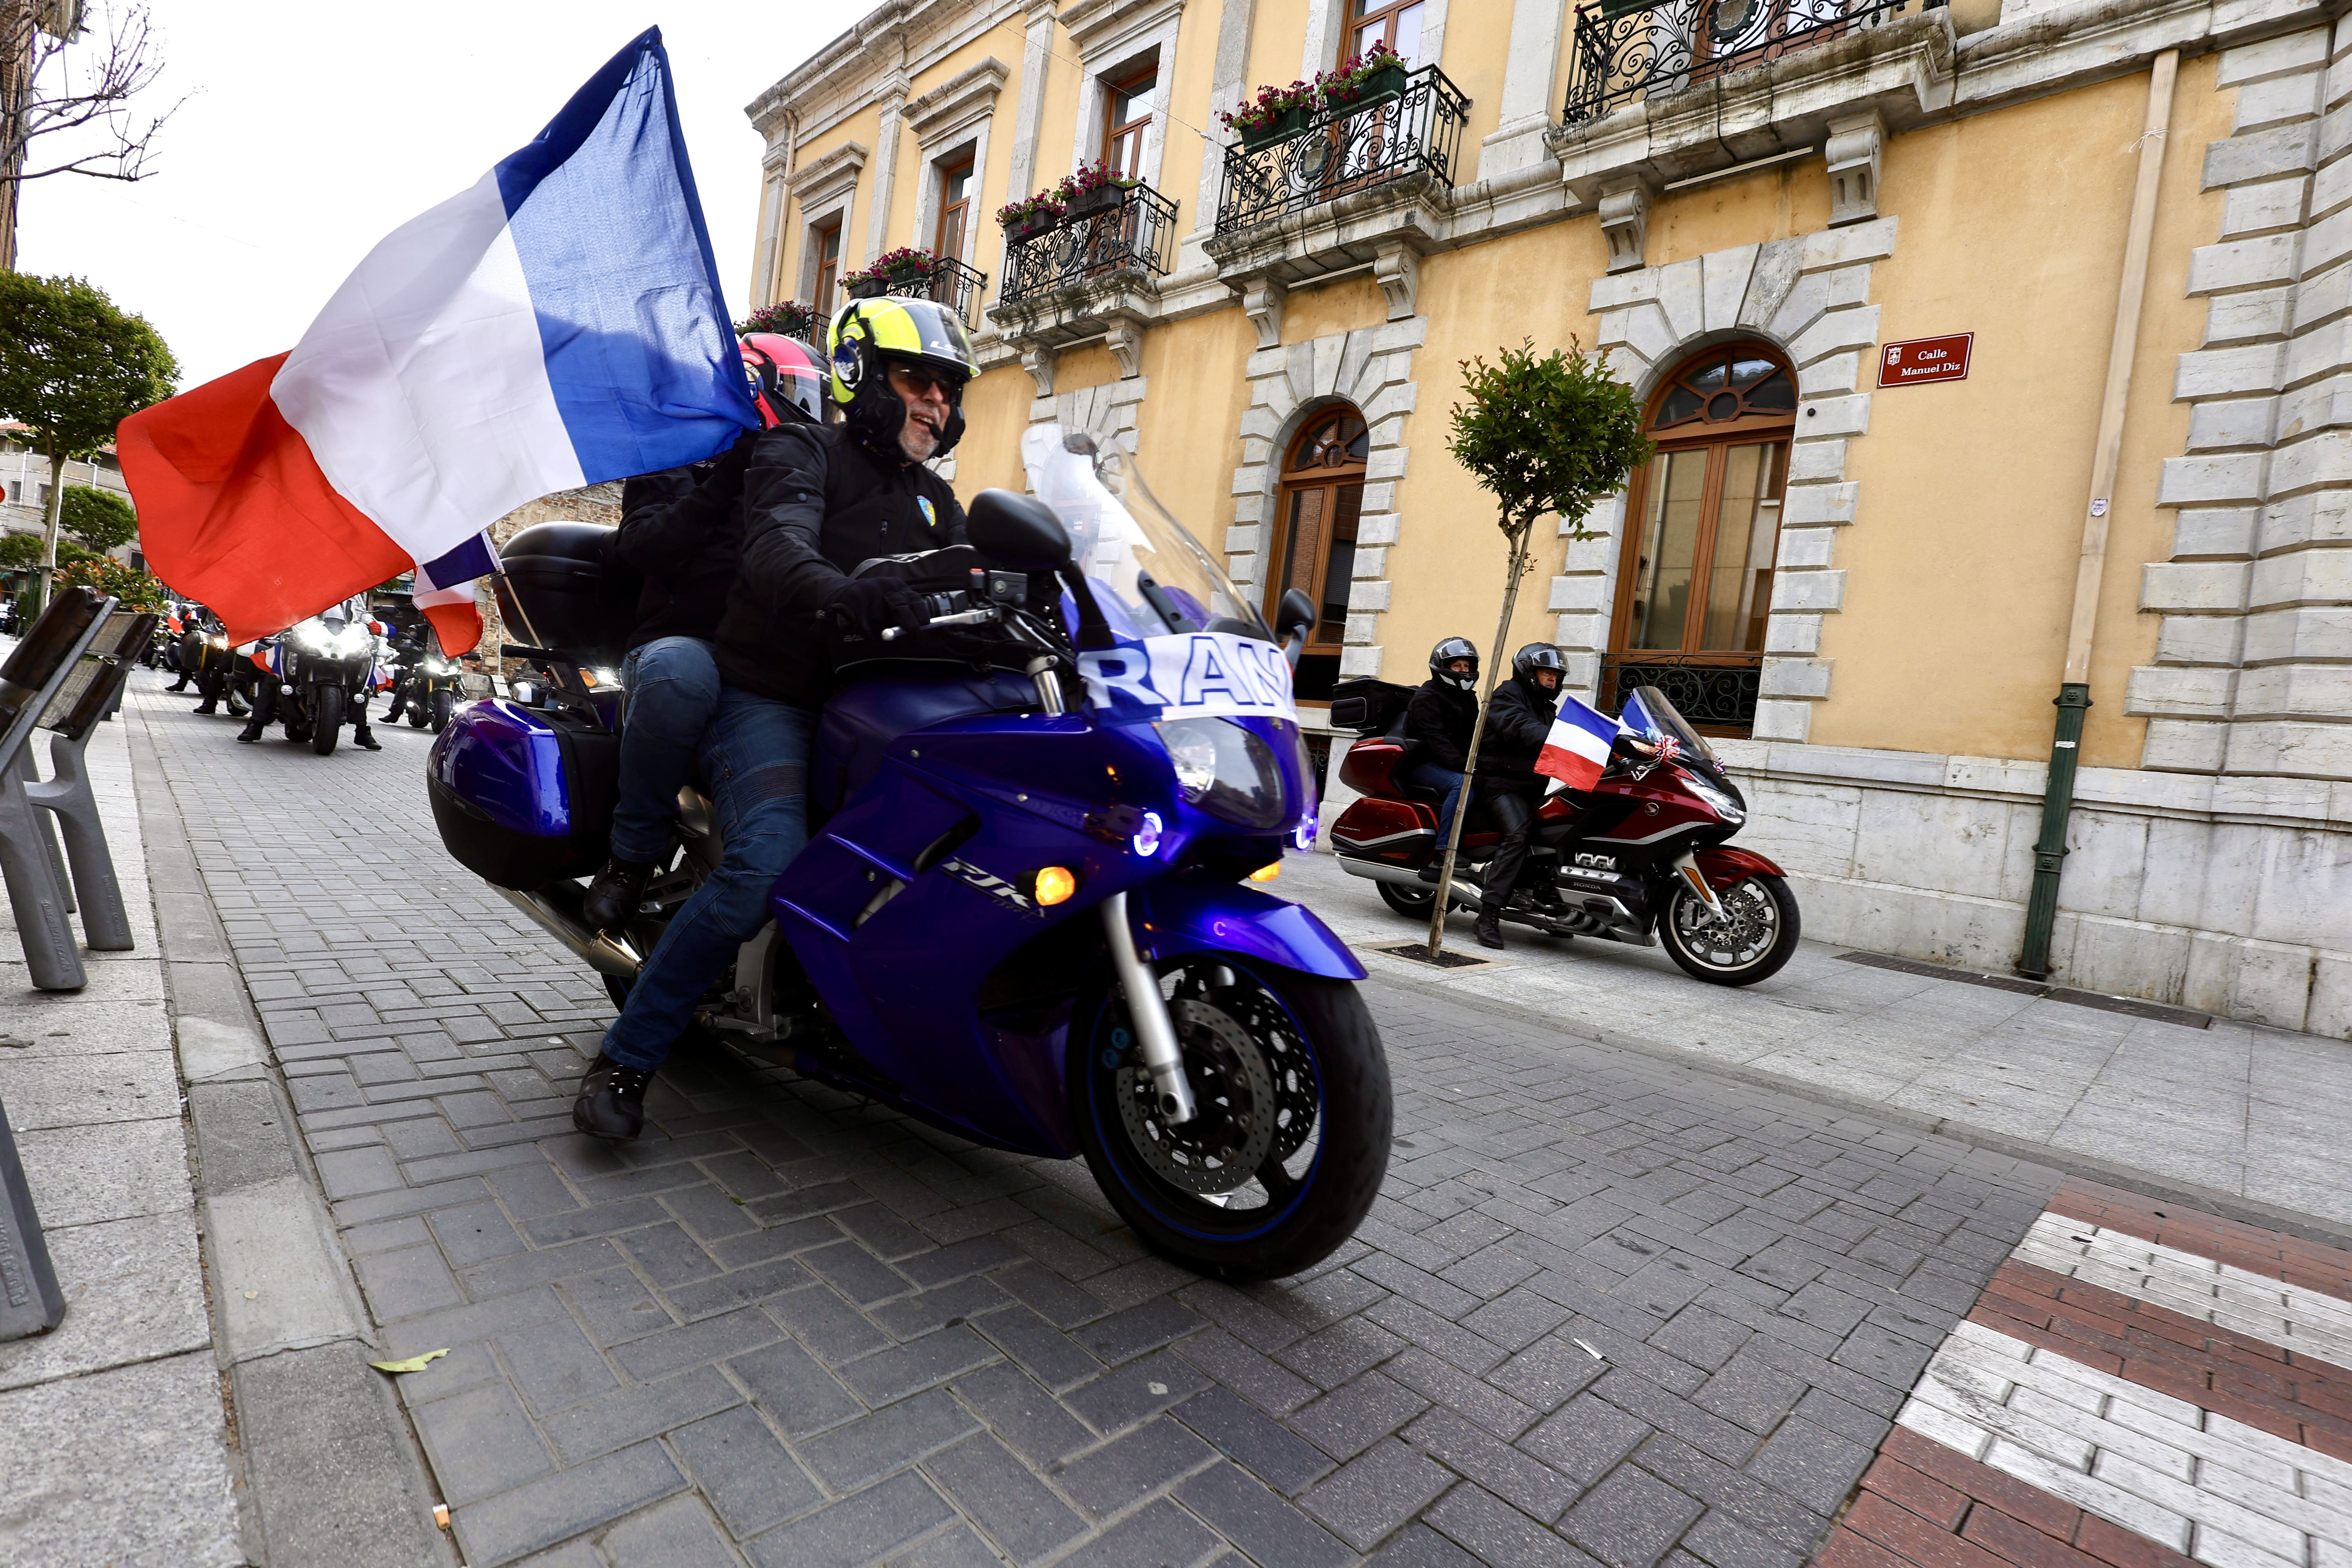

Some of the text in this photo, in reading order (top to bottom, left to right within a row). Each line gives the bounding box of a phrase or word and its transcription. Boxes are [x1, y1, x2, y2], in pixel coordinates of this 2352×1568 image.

[1918, 349, 1947, 360] Calle
[1900, 362, 1961, 376] Manuel Diz
[1573, 882, 1602, 890] HONDA
